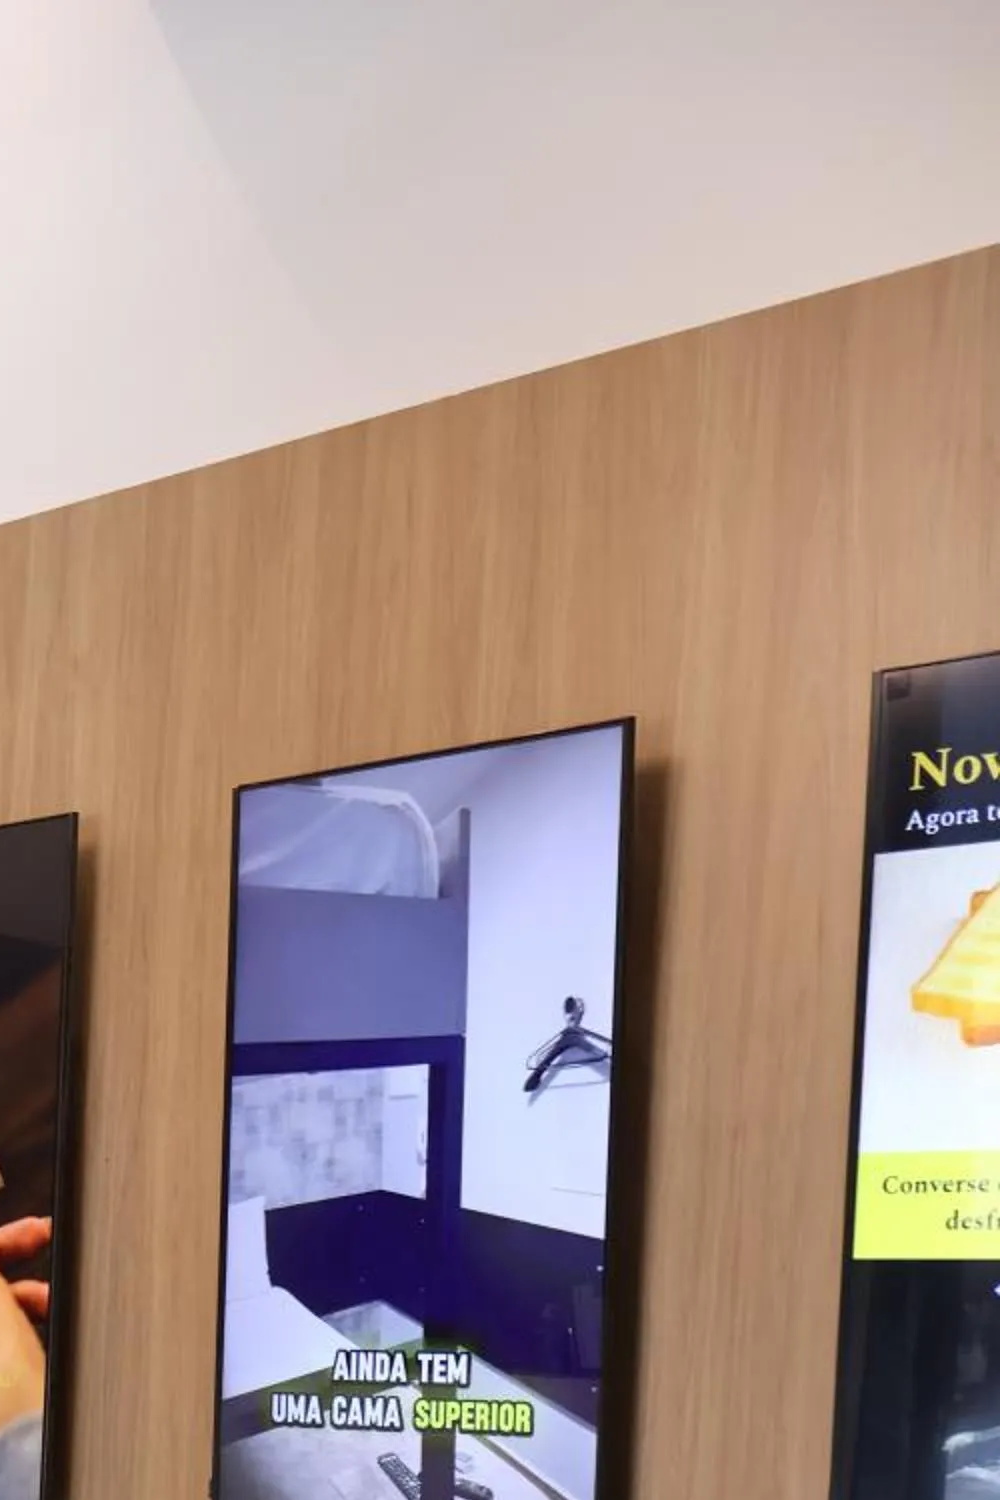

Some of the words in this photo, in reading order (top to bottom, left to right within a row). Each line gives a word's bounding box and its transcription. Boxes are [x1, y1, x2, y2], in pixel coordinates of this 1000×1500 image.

[904, 808, 980, 835] Agora
[882, 1175, 990, 1195] Converse
[332, 1350, 408, 1384] AINDA
[417, 1352, 469, 1386] TEM
[271, 1392, 323, 1425] UMA
[331, 1395, 402, 1429] CAMA
[414, 1399, 532, 1434] SUPERIOR
